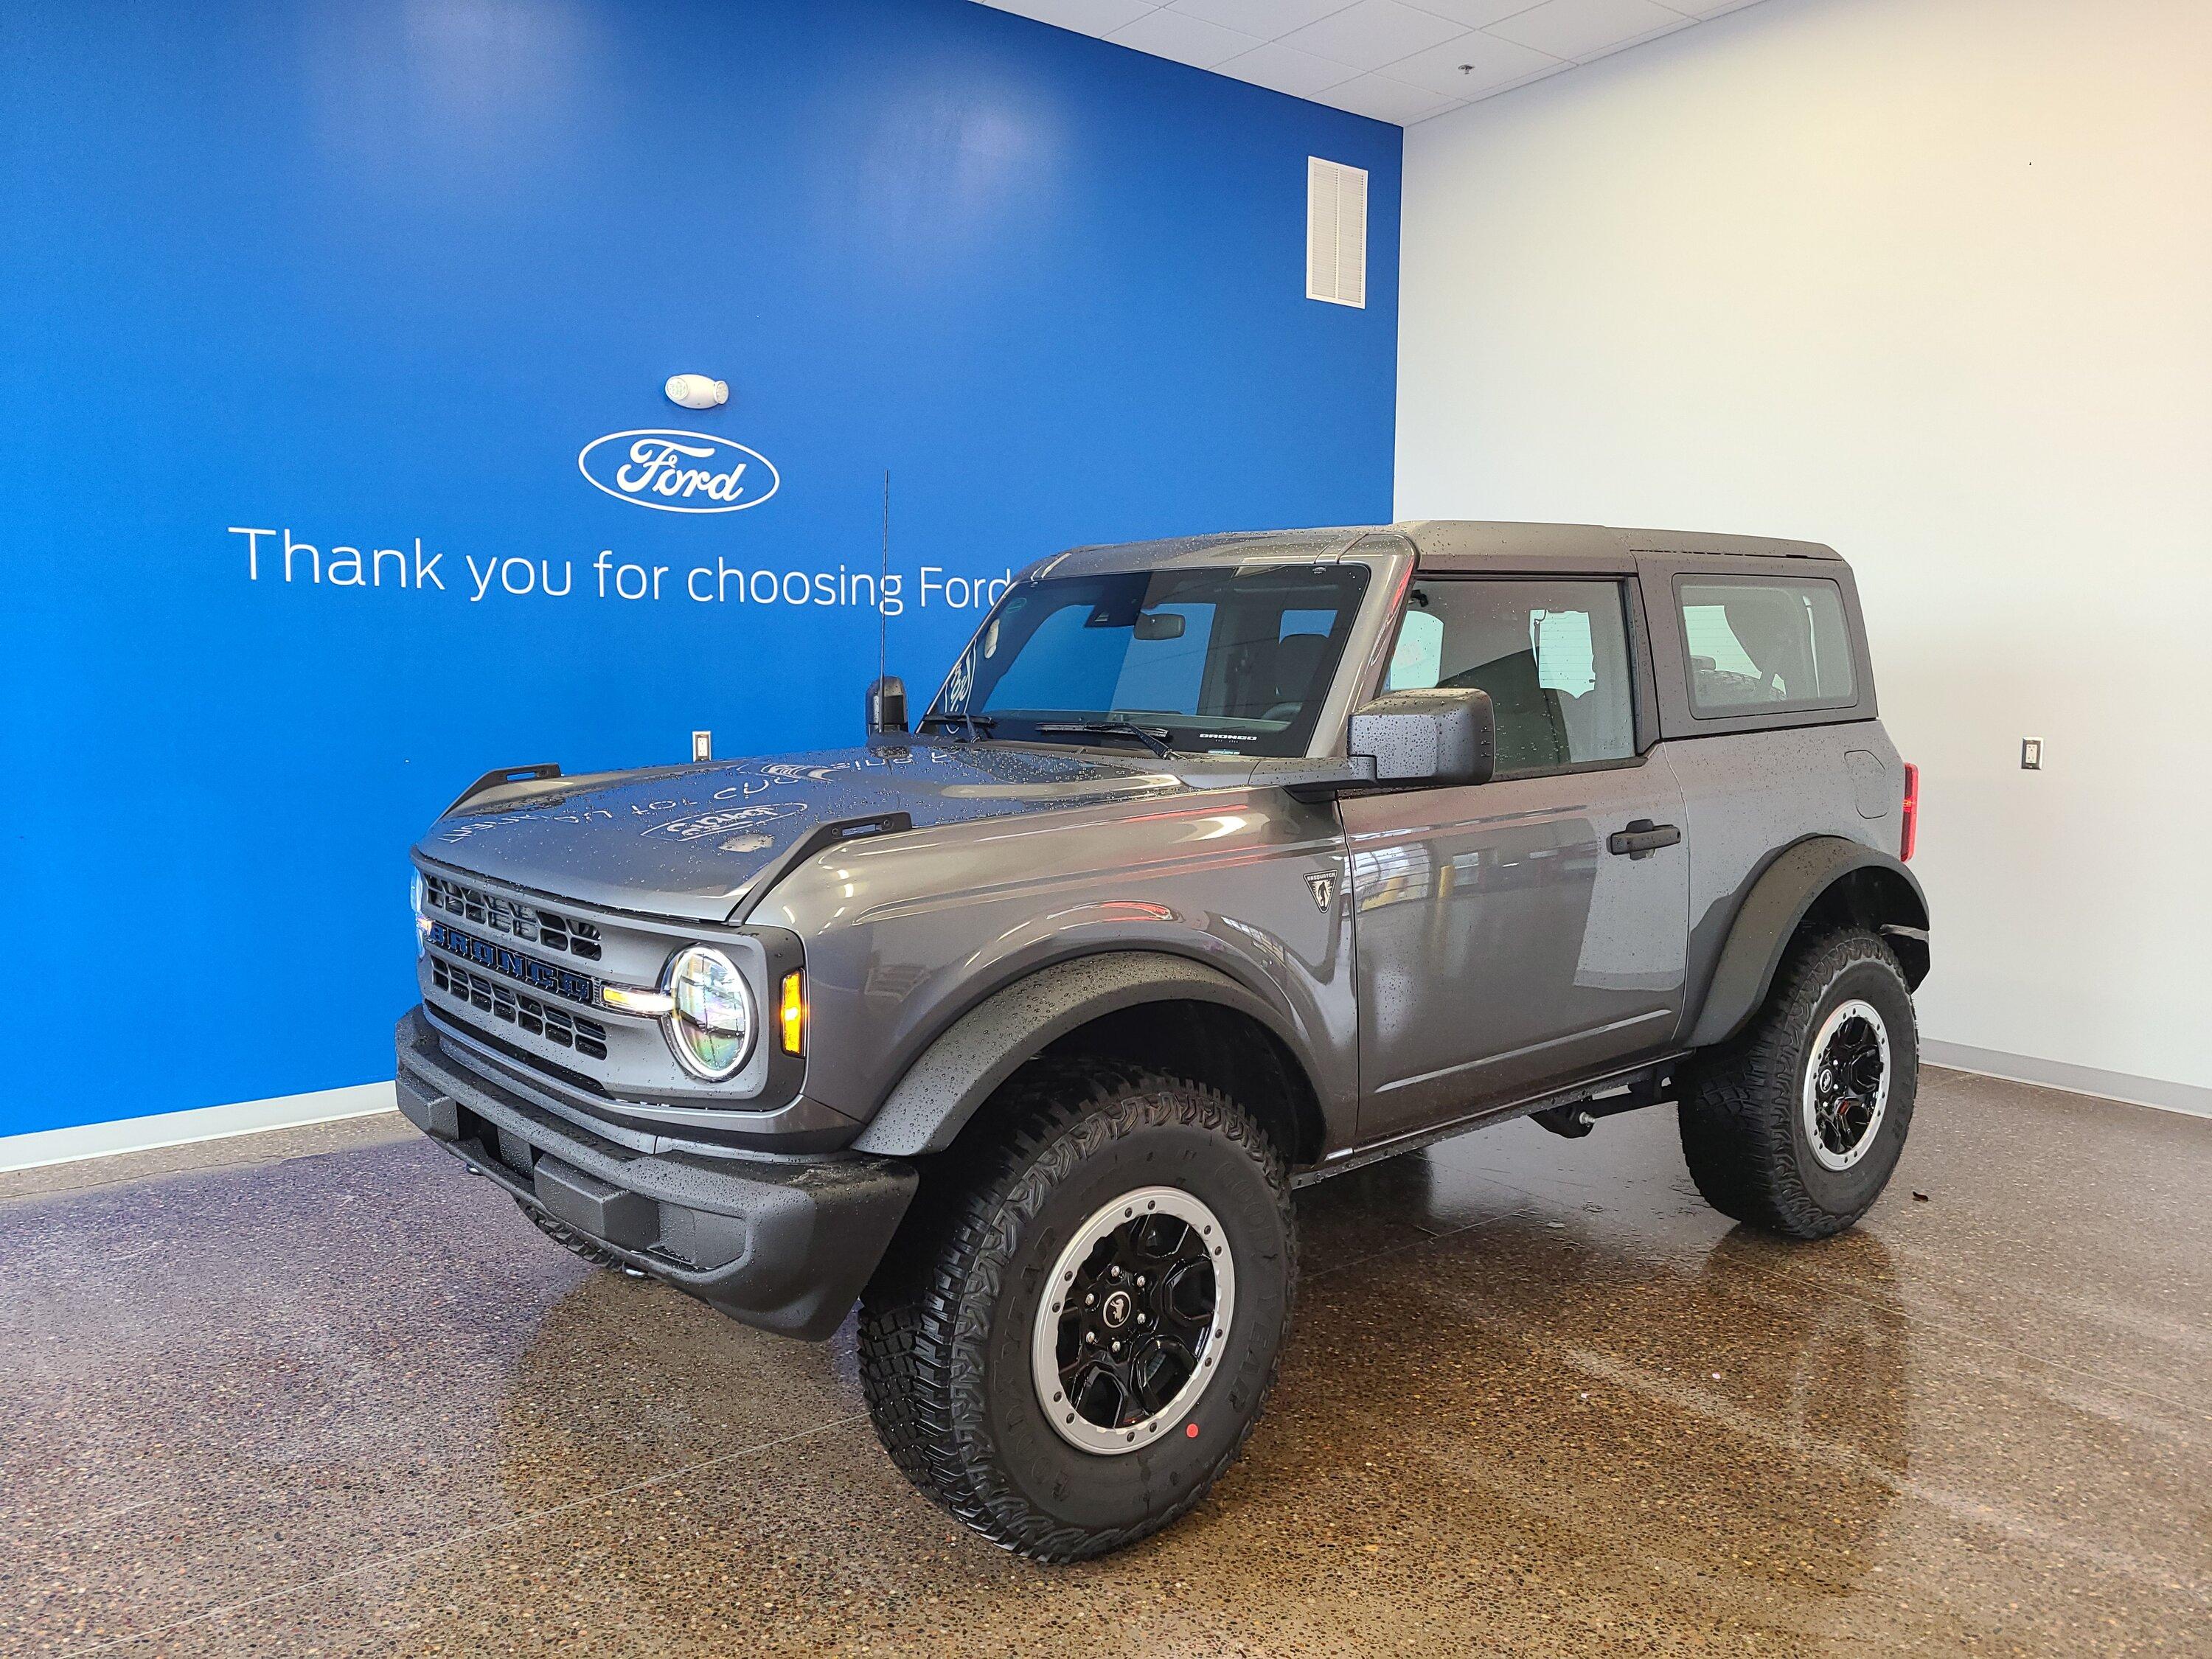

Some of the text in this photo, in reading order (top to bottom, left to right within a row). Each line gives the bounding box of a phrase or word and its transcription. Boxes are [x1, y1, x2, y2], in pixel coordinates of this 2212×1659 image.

[616, 438, 747, 501] Ford
[228, 527, 1011, 616] Thank you for choosing Ford
[1307, 872, 1335, 881] SASQUATCH
[429, 922, 590, 998] BRONCO
